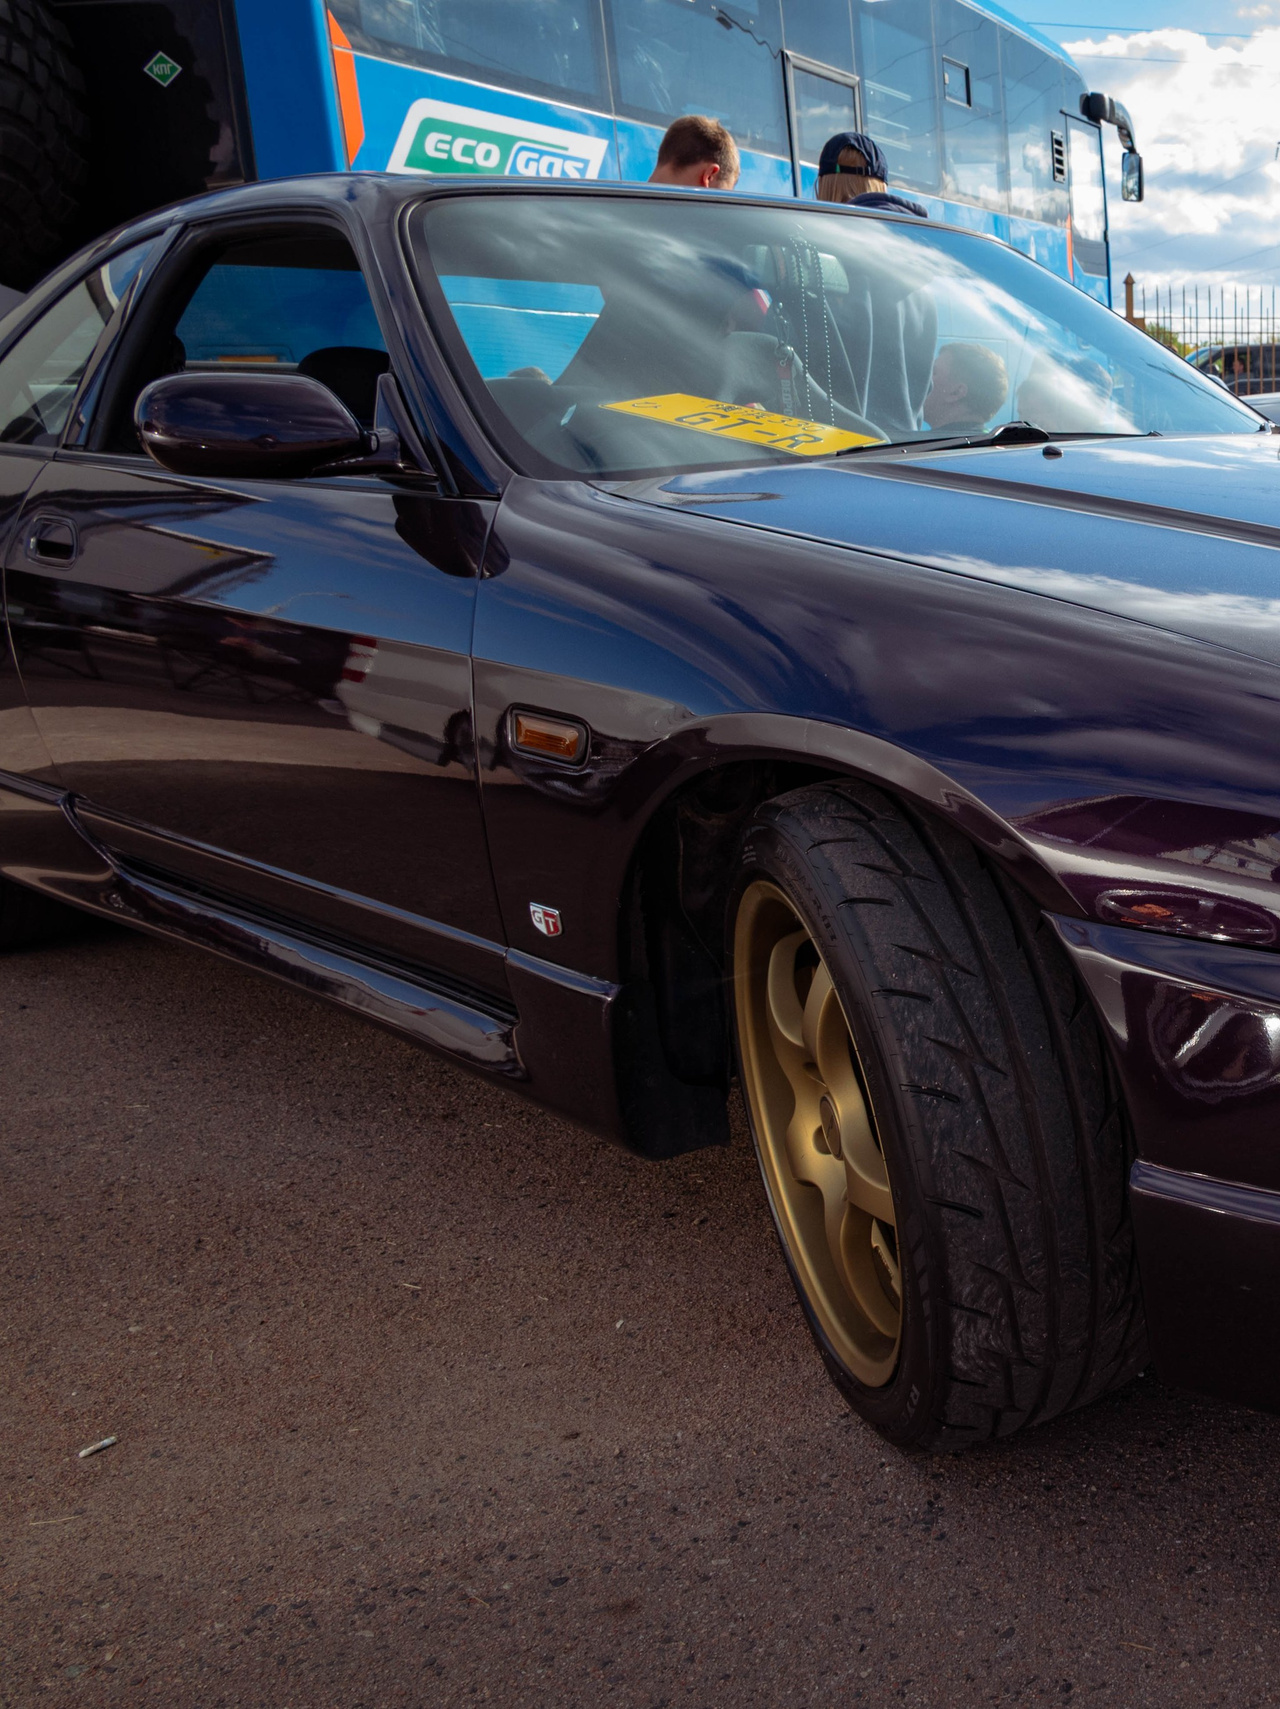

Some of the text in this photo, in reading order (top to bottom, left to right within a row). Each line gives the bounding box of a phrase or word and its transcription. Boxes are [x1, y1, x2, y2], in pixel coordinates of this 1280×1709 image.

[424, 131, 501, 169] ECO
[674, 411, 824, 450] GT-R
[532, 909, 556, 933] GT
